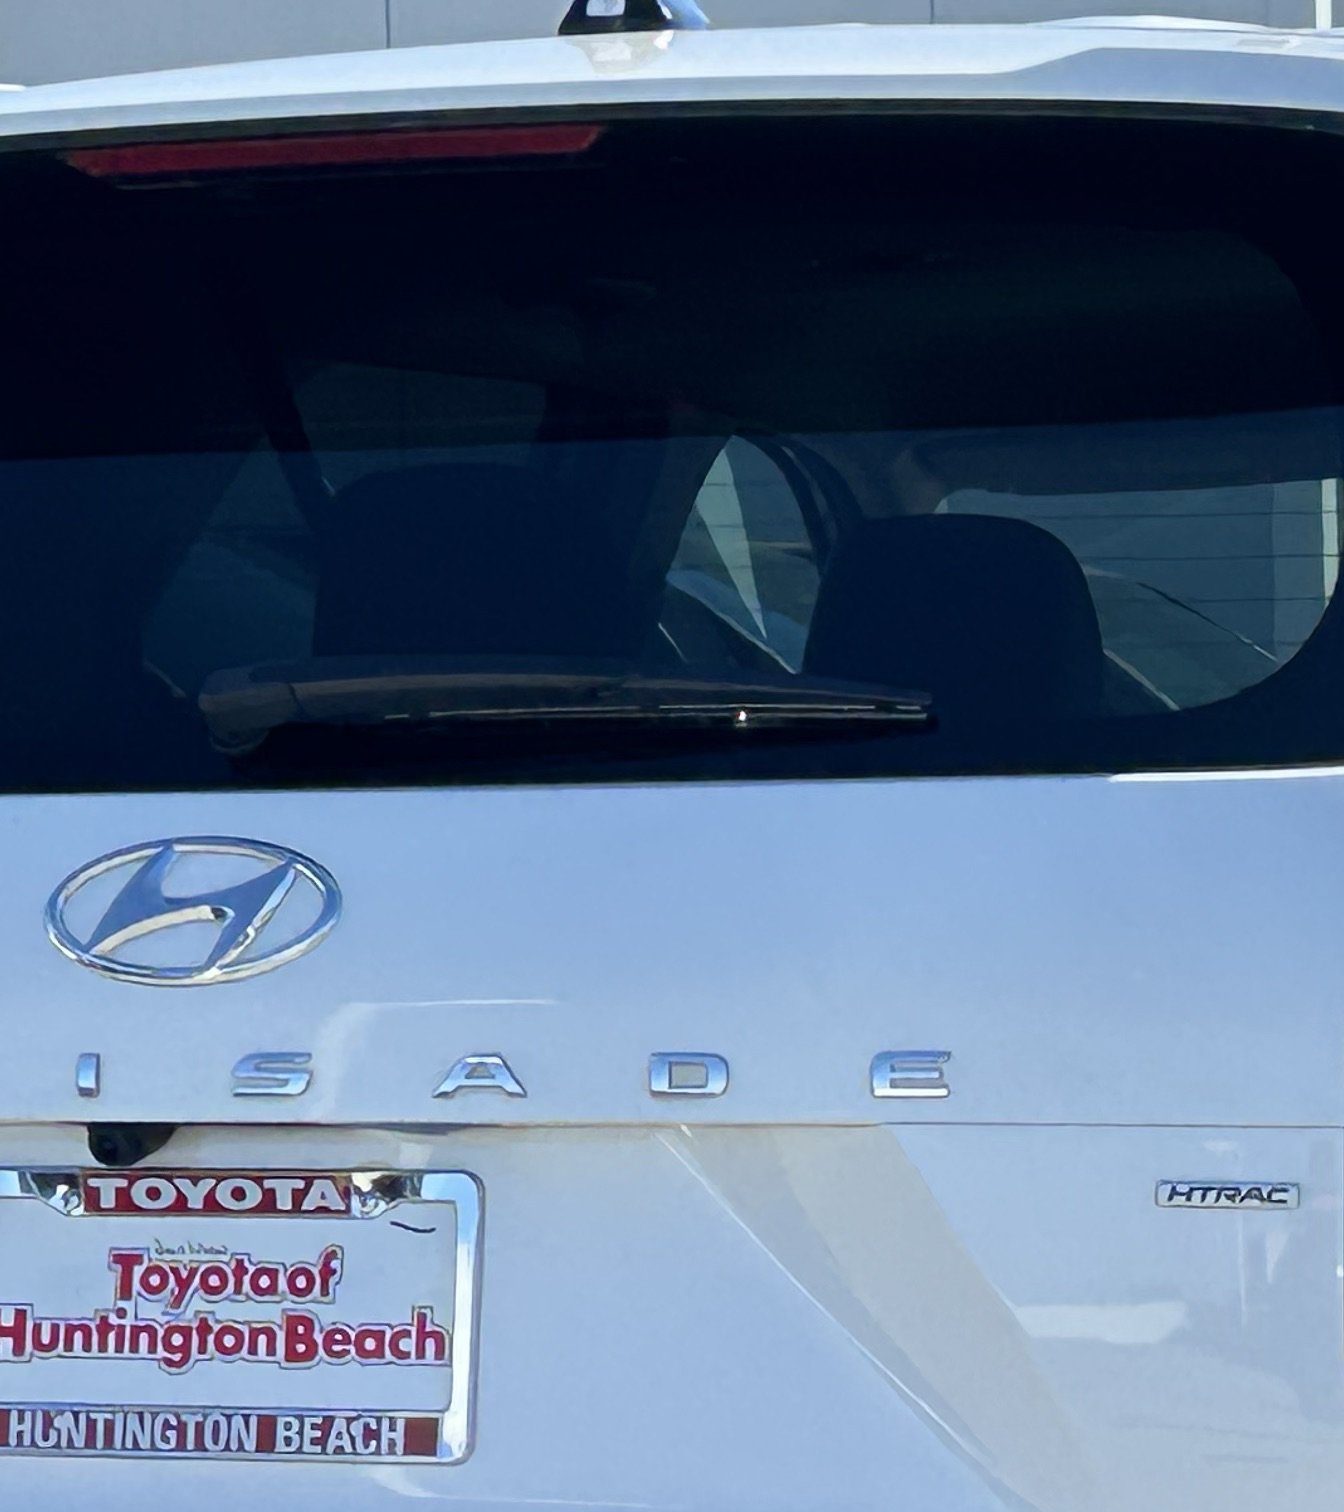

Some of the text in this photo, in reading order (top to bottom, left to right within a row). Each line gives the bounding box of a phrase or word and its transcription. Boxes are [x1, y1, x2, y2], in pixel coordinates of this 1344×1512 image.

[86, 1176, 347, 1212] TOYOTA
[1166, 1184, 1290, 1204] HTRAC
[284, 1311, 446, 1363] Beach
[7, 1408, 406, 1456] HUNTINGTON BEACH
